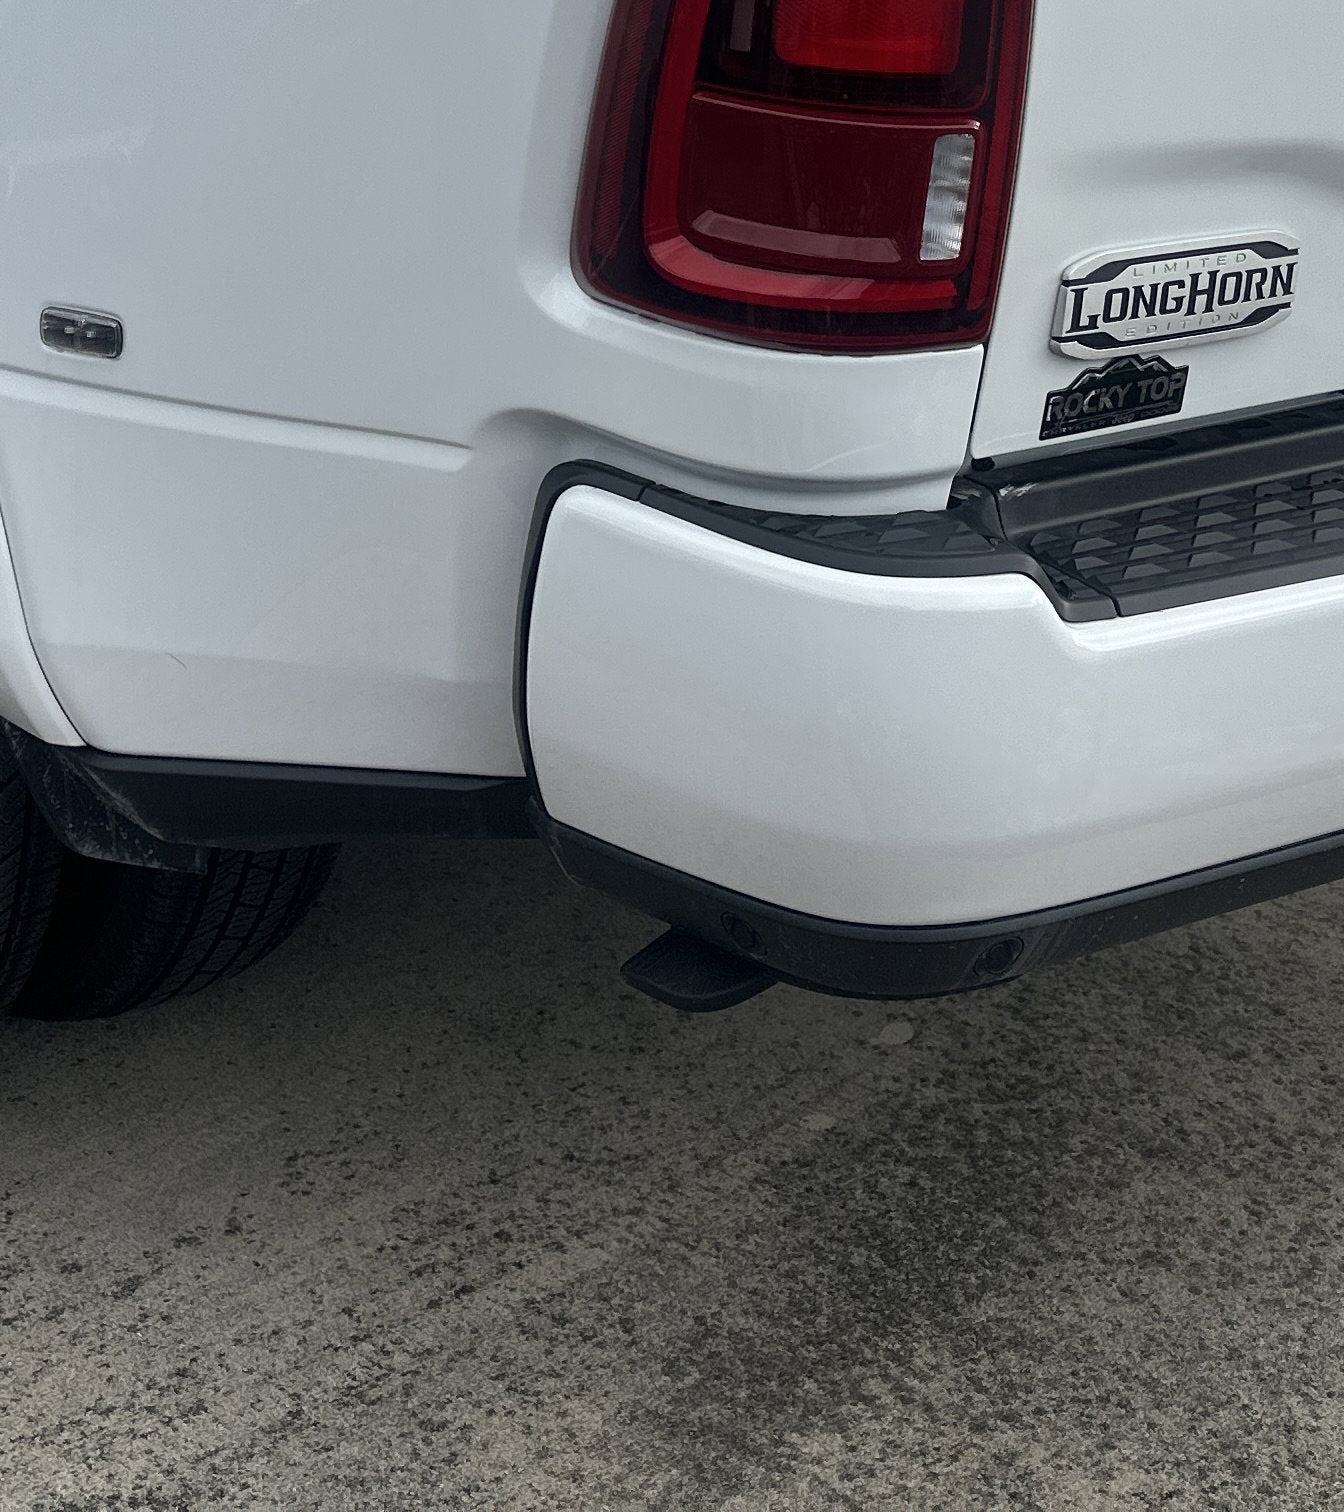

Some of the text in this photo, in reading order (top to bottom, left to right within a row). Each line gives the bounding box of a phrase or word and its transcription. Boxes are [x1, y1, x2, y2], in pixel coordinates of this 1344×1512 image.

[1133, 252, 1247, 277] LIMITED
[1124, 311, 1240, 338] EDITION
[1047, 371, 1187, 422] ROCKY TOP
